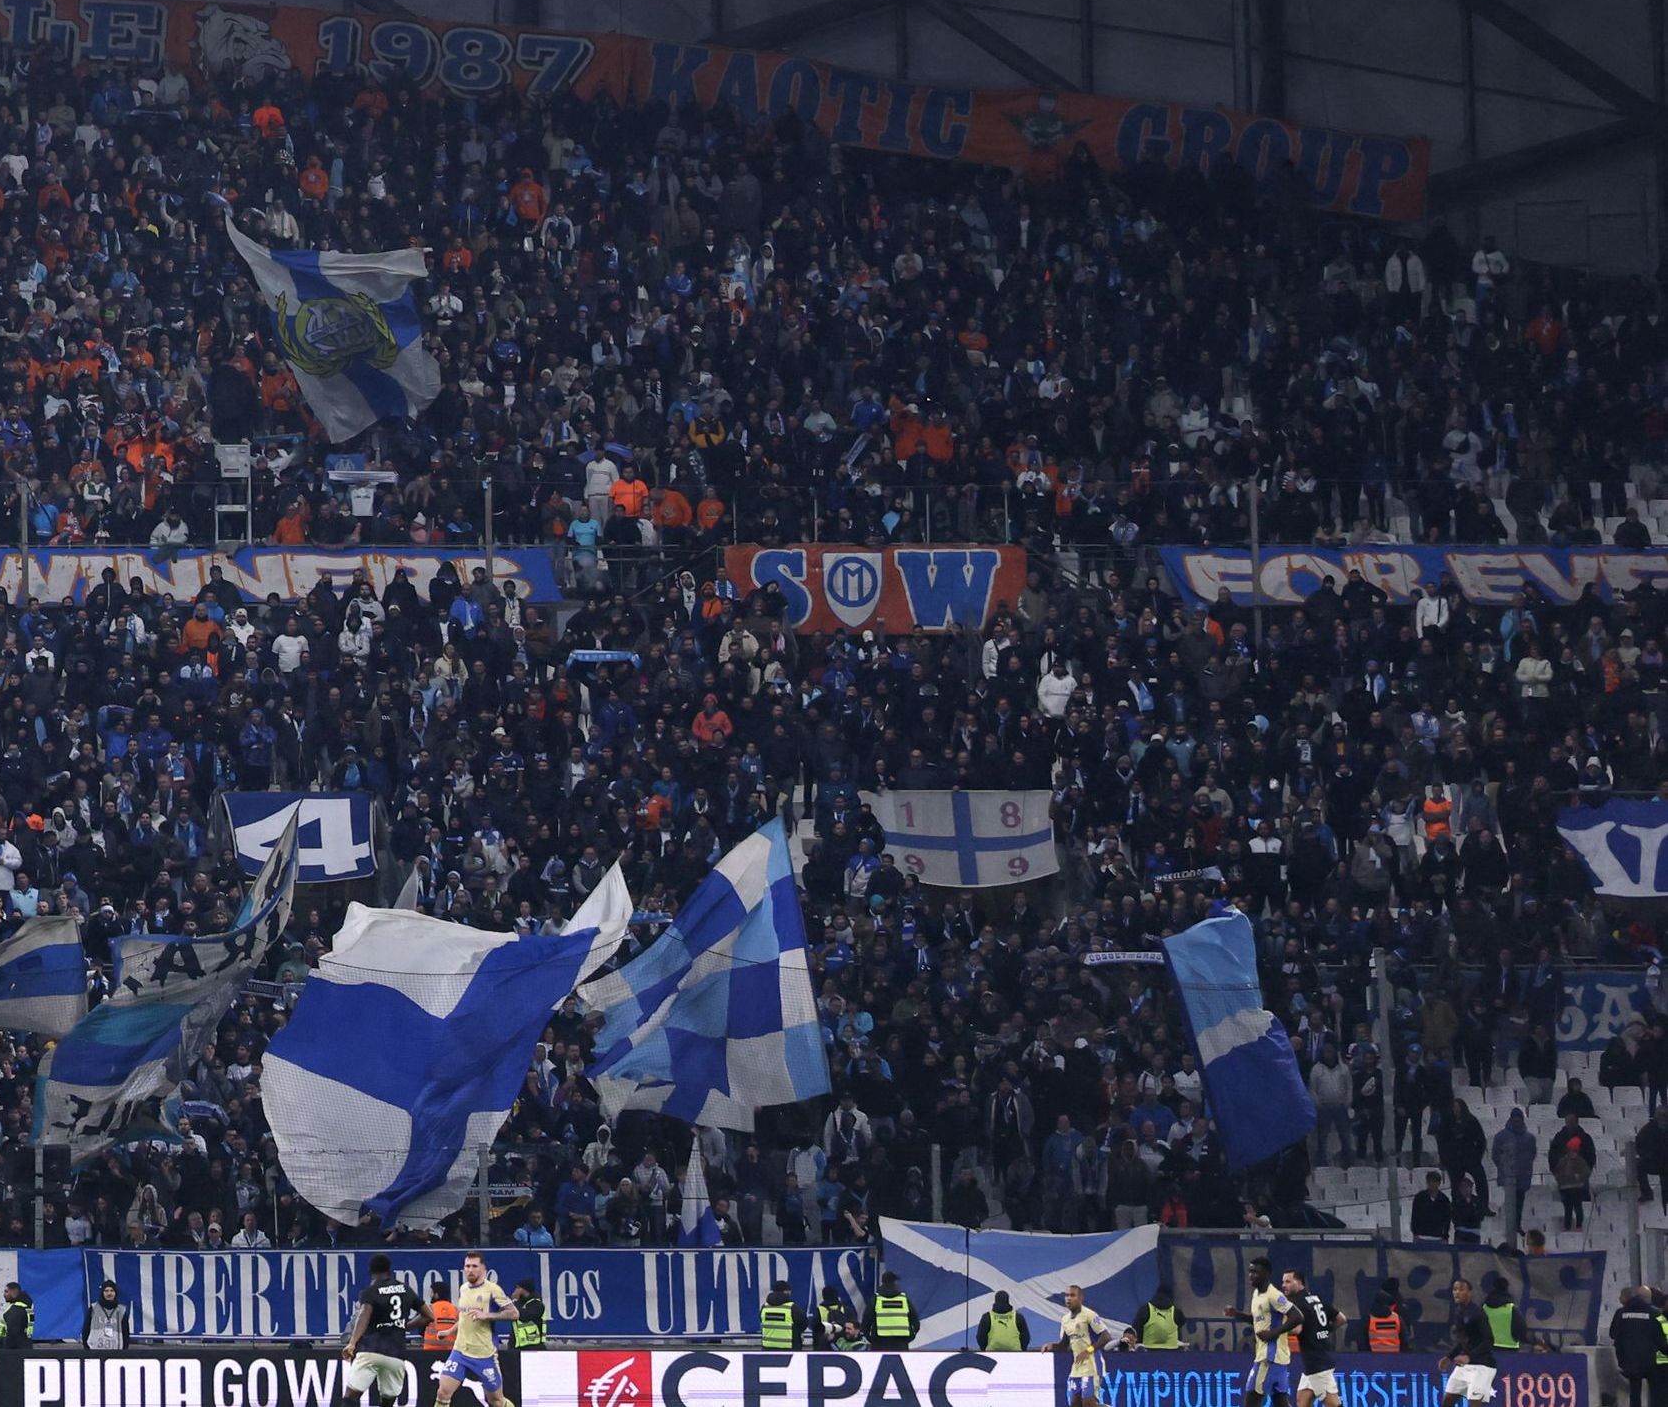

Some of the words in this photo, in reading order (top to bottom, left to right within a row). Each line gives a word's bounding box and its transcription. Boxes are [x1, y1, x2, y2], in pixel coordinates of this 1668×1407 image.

[316, 15, 595, 96] 1987
[648, 42, 973, 160] KAOTIC
[1114, 103, 1410, 218] GROUP
[234, 798, 371, 876] 4
[899, 800, 916, 828] 1
[1000, 801, 1022, 828] 8
[1007, 856, 1030, 877] 9
[104, 1252, 356, 1338] LIBERTE
[539, 1253, 601, 1321] les
[641, 1250, 865, 1335] ULTRAS
[389, 1295, 402, 1321] 3
[1172, 1245, 1596, 1331] UTRAS
[22, 1358, 203, 1407] PUMA
[212, 1359, 279, 1407] GO
[445, 1361, 458, 1372] 23
[661, 1352, 998, 1407] CEPAC
[1099, 1369, 1242, 1407] YMPIQUE
[1501, 1372, 1577, 1407] 1899
